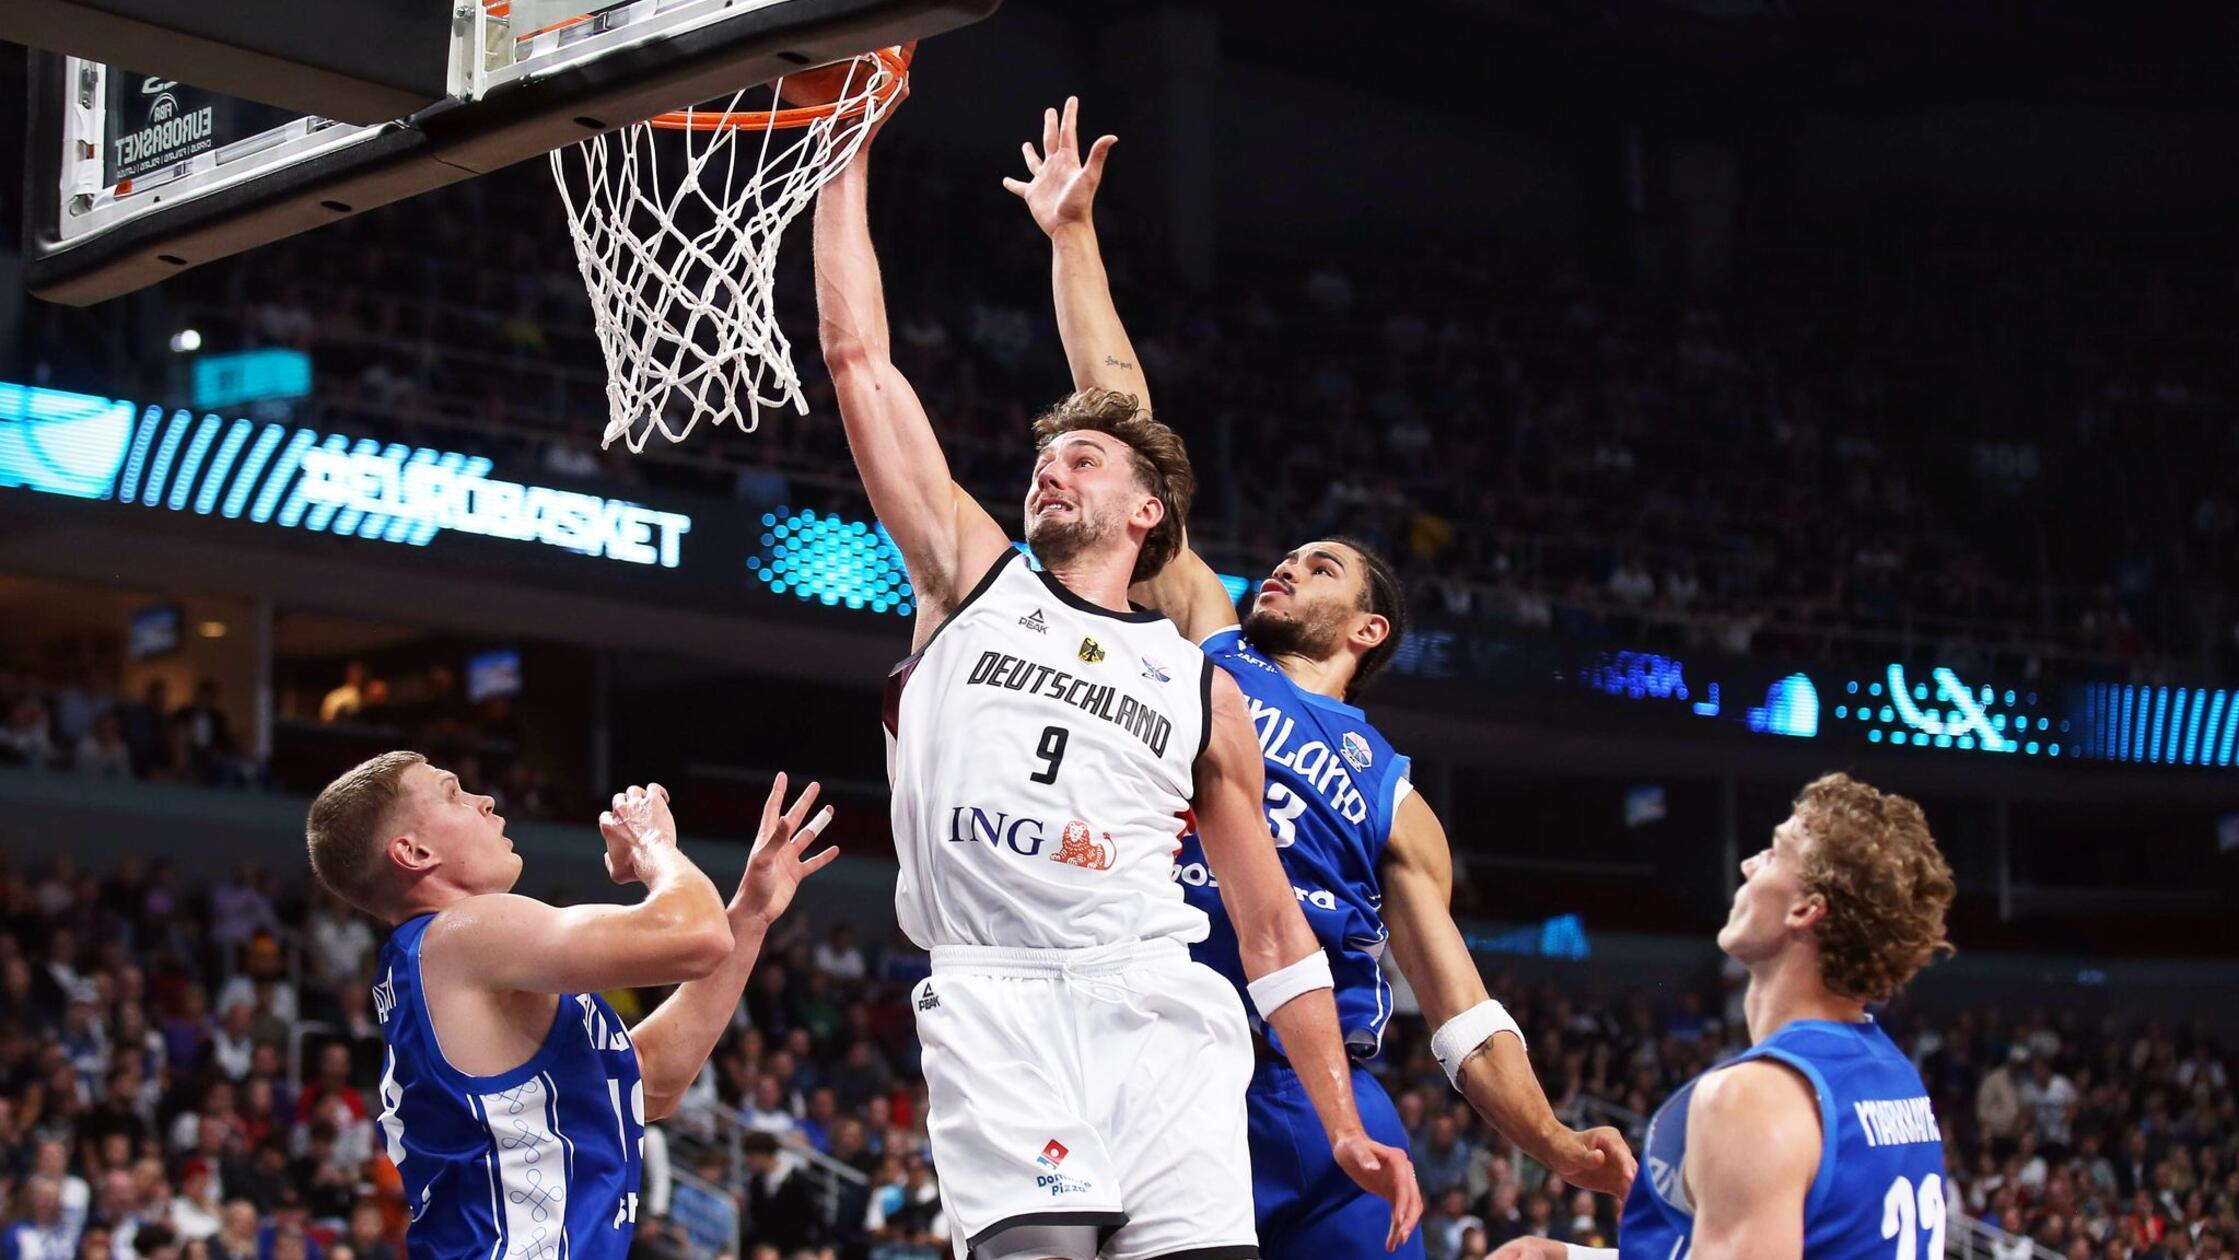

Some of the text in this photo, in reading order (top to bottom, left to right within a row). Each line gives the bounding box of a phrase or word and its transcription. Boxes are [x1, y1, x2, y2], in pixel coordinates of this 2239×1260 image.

[1018, 616, 1050, 635] PEAK
[966, 650, 1173, 759] DEUTSCHLAND
[1030, 725, 1070, 785] 9
[948, 806, 1046, 856] ING
[918, 996, 942, 1012] PEAK
